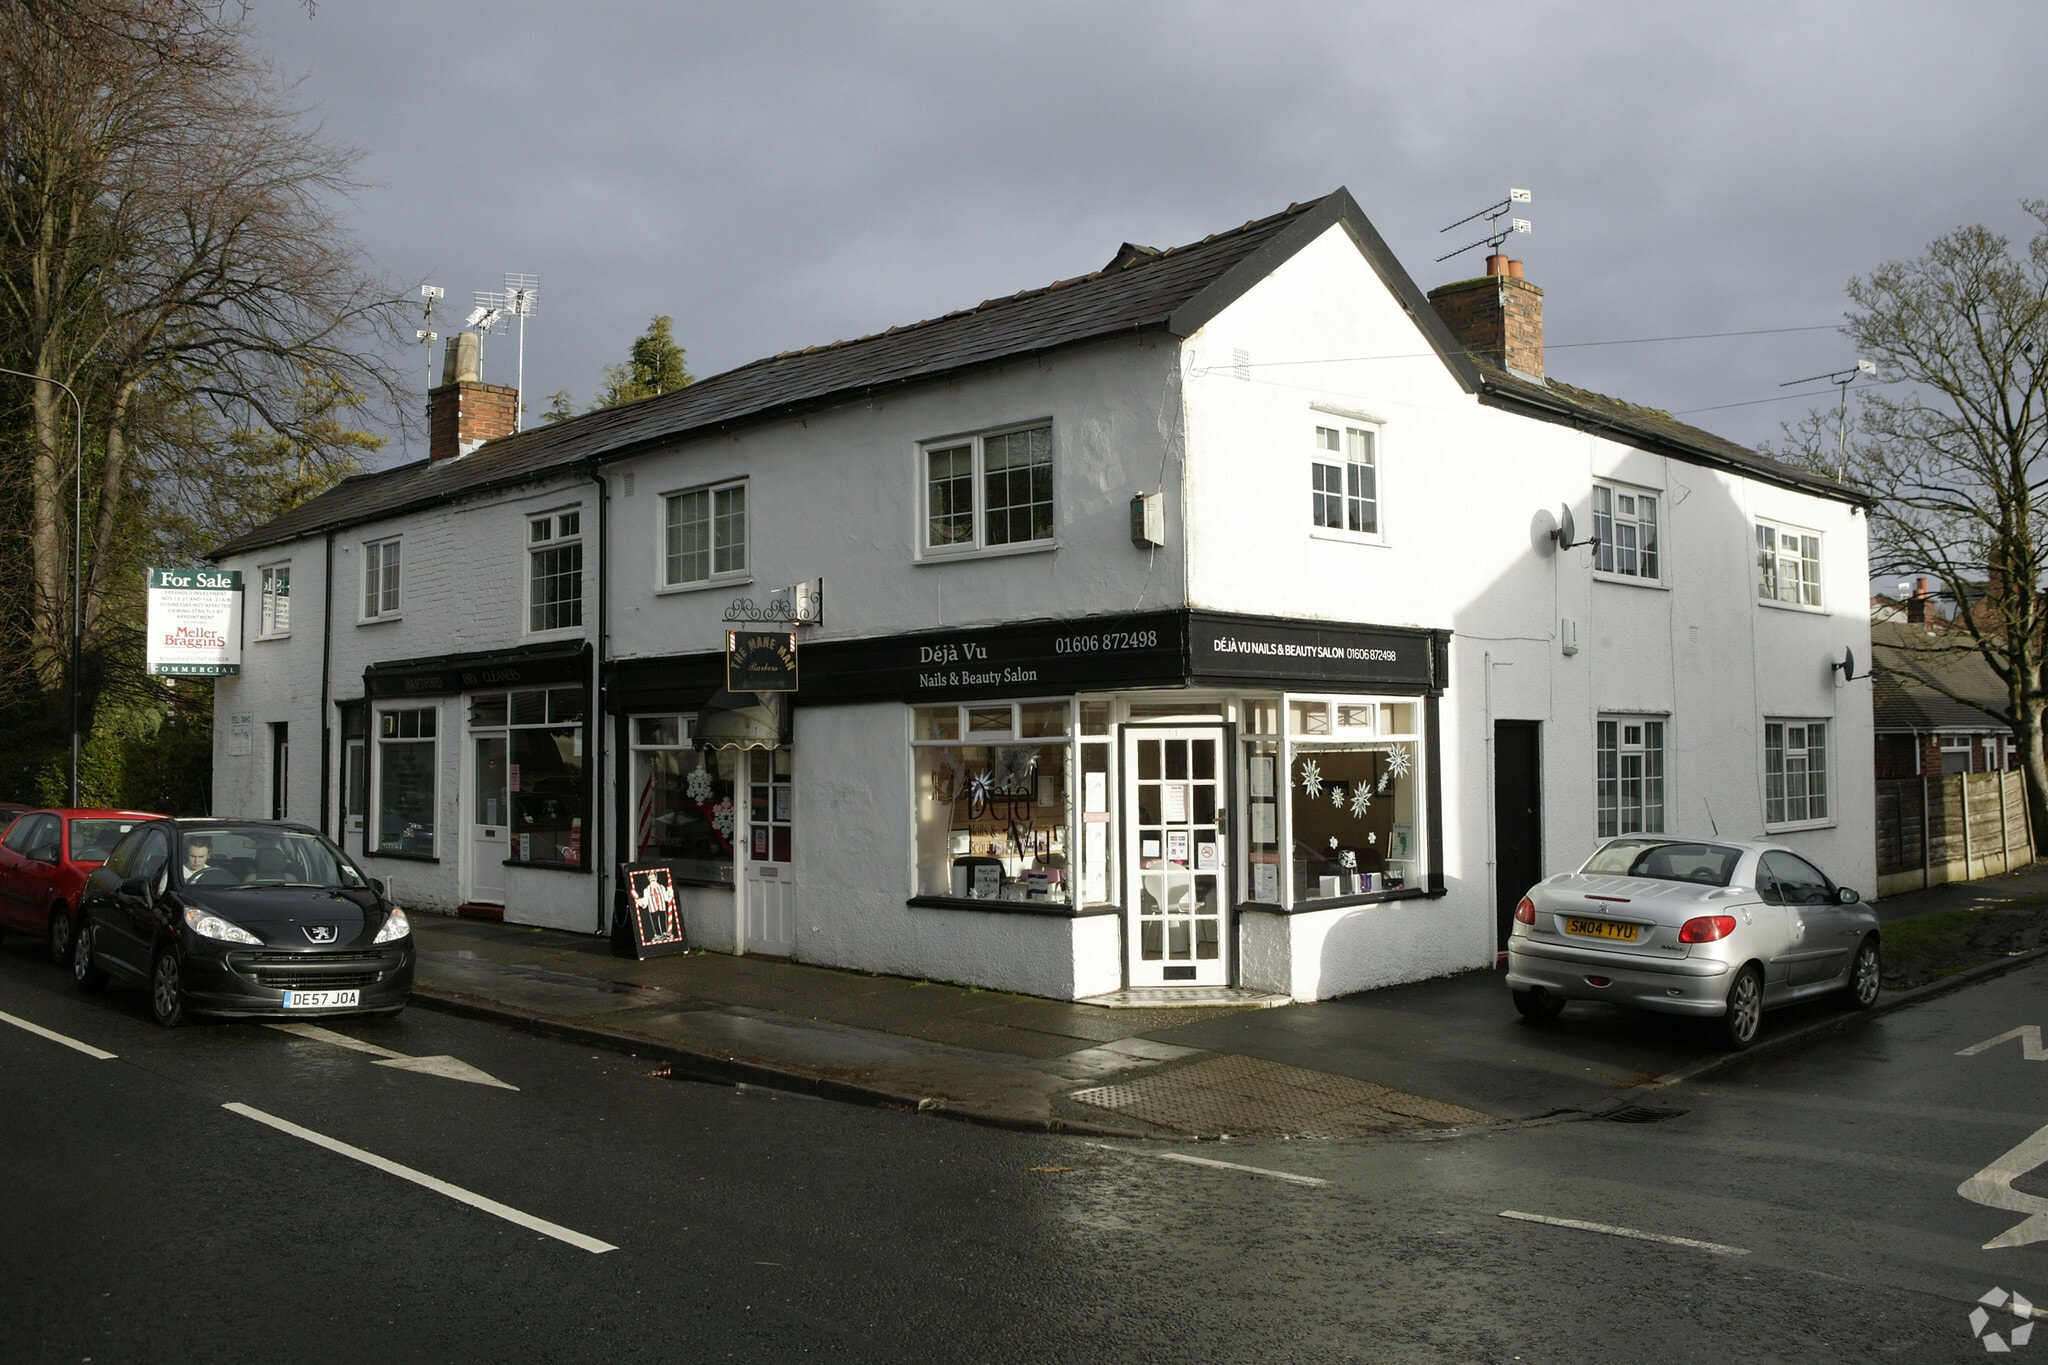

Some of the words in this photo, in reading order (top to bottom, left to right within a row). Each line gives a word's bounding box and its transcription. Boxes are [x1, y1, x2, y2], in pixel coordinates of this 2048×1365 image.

[160, 572, 192, 587] For
[196, 573, 232, 588] Sale
[176, 626, 218, 639] Meller
[1055, 635, 1099, 654] 01606
[1102, 630, 1157, 650] 872498
[731, 646, 748, 669] THE
[748, 636, 776, 650] MANE
[776, 645, 796, 671] MAN
[962, 643, 988, 660] Vu
[1213, 636, 1237, 653] DÉJÀ
[1237, 641, 1251, 654] VU
[1251, 642, 1277, 655] NAILS
[1277, 644, 1285, 656] &
[1285, 644, 1317, 658] BEAUTY
[1317, 646, 1345, 659] SALON
[1346, 648, 1369, 660] 01606
[1370, 649, 1397, 662] 872498
[481, 669, 521, 683] CLEANERS
[919, 672, 947, 688] Nails
[949, 672, 960, 686] &
[962, 670, 1002, 686] Beauty
[1004, 667, 1038, 683] Salon
[1011, 820, 1050, 864] Vu
[1570, 919, 1604, 936] SM04
[1607, 922, 1634, 939] TYU
[293, 993, 329, 1006] DE57
[332, 992, 356, 1005] JOA
